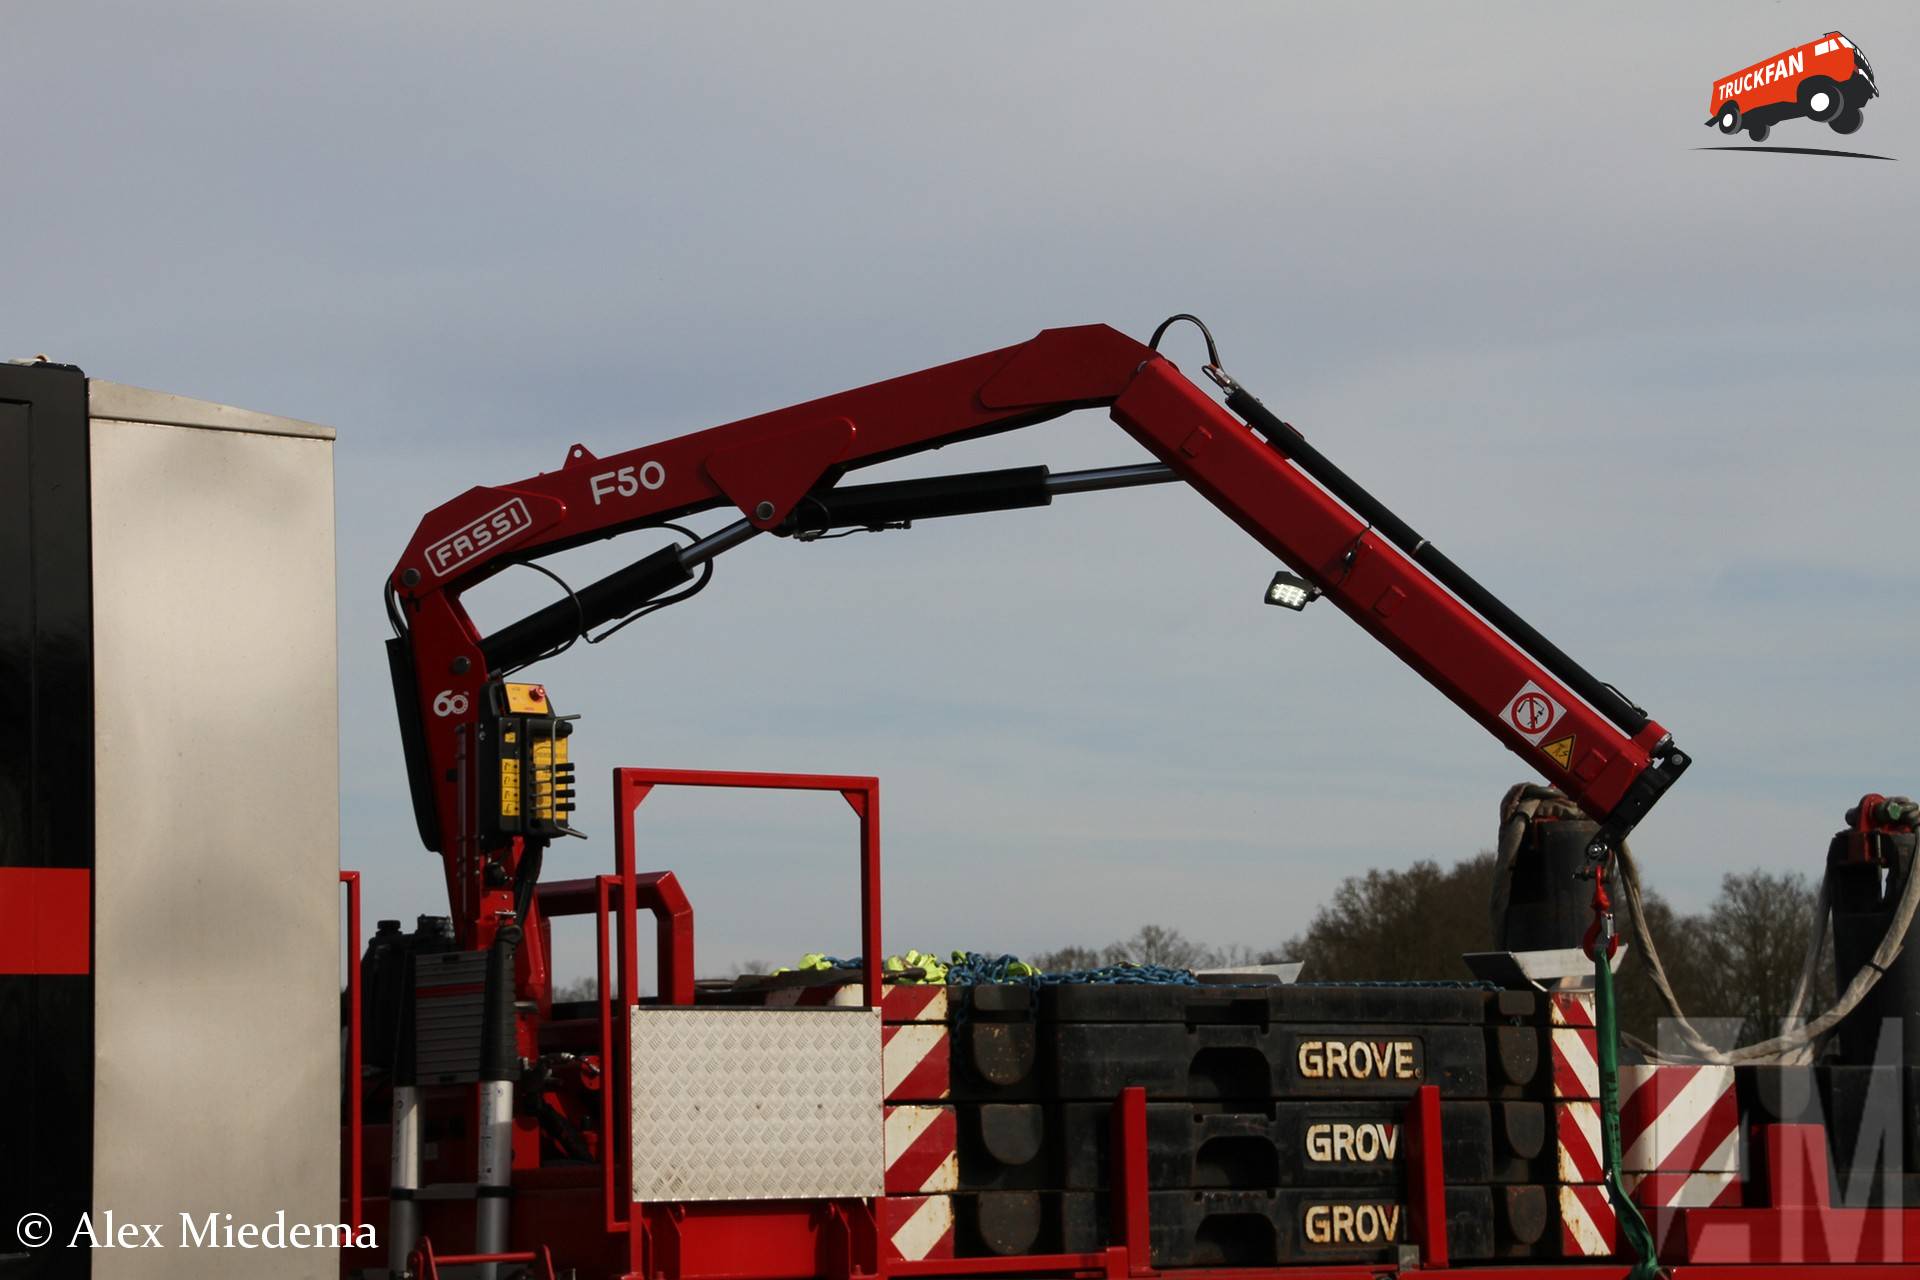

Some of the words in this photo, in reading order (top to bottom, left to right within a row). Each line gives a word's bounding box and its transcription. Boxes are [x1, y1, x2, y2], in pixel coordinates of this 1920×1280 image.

[590, 460, 666, 505] F50
[435, 507, 522, 567] FASSI
[1306, 1123, 1399, 1162] GROV
[1305, 1204, 1400, 1243] GROV
